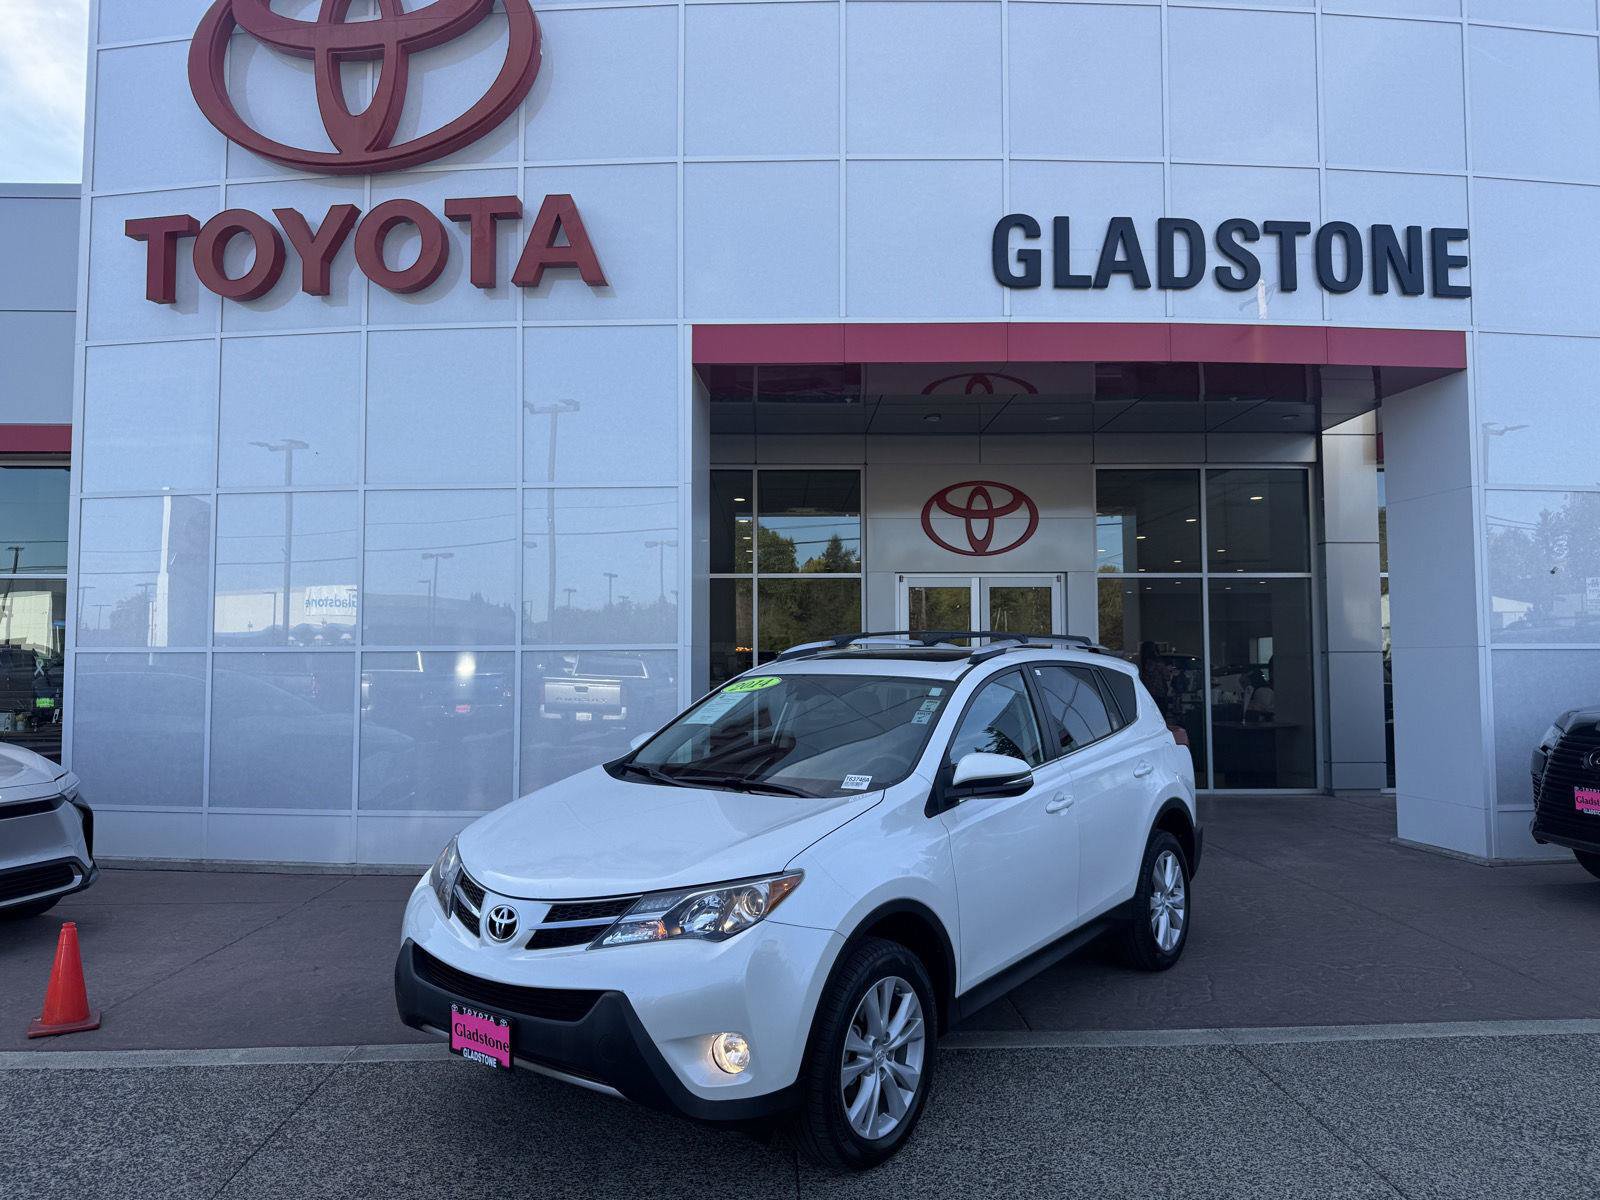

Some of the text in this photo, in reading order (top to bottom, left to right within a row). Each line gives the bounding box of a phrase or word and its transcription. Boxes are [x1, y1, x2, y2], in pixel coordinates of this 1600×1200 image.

[125, 194, 609, 305] TOYOTA
[992, 213, 1472, 298] GLADSTONE
[728, 678, 774, 691] 2014
[462, 1007, 496, 1023] TOYOTA
[454, 1022, 510, 1053] Gladstone
[462, 1047, 498, 1068] GLADSTONE
